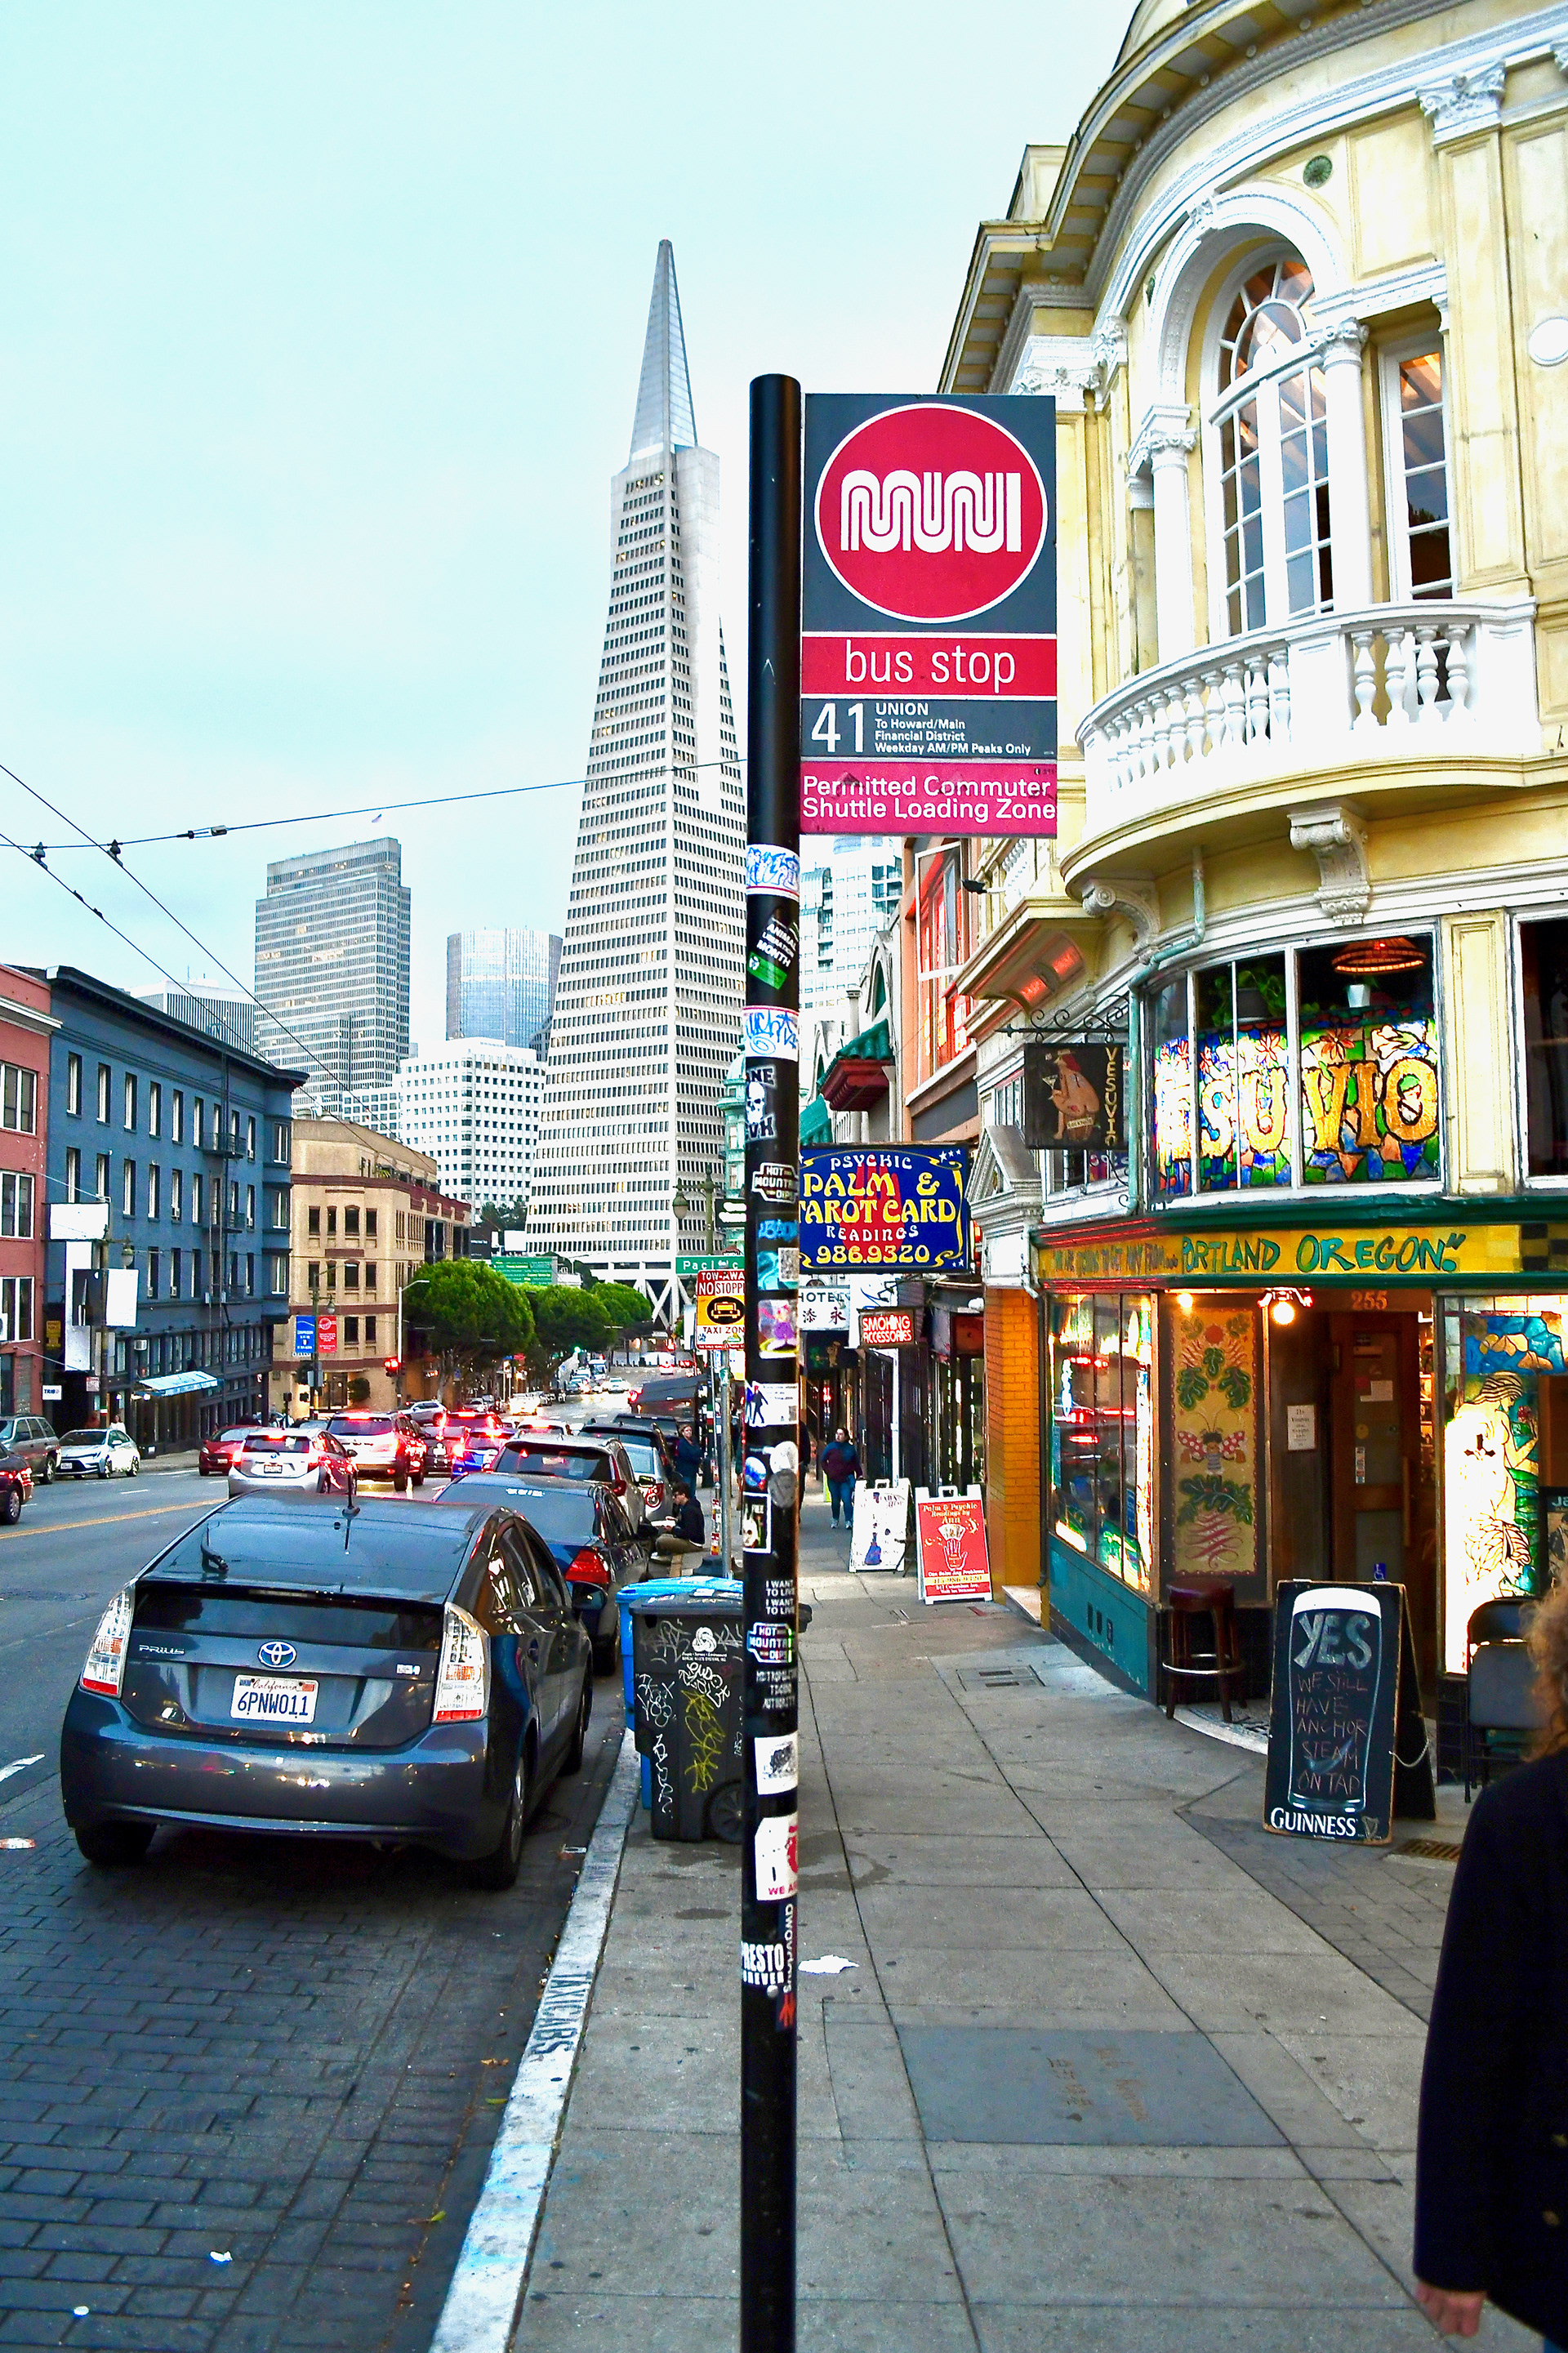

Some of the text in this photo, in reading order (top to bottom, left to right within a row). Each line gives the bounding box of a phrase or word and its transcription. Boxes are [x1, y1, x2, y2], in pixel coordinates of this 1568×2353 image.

[840, 470, 1022, 553] MUNI
[845, 639, 1015, 693] bus stop
[875, 702, 929, 715] UNION
[811, 702, 864, 752] 41
[875, 719, 965, 729] To Howard/Main
[875, 731, 965, 741] Financial District
[875, 742, 924, 755] Weekday
[927, 743, 969, 754] AM/PM
[972, 744, 1003, 754] Peaks
[1005, 744, 1031, 756] Only
[804, 776, 1050, 796] Permitted Commuter
[803, 797, 1056, 823] Shuttle Loading Zone
[756, 939, 791, 967] MONTH
[1104, 1046, 1118, 1147] VESUVIO
[830, 1153, 912, 1170] PSYCHIC
[803, 1171, 940, 1197] PALM &
[883, 1199, 956, 1223] CARD
[826, 1225, 919, 1241] READINGS
[816, 1245, 930, 1263] 986.9320
[1182, 1236, 1281, 1272] PORTLAND
[702, 1272, 745, 1281] TOW-AWA
[699, 1282, 715, 1295] NO
[1352, 1290, 1388, 1310] 255
[862, 1314, 911, 1331] SMOKING
[765, 1588, 778, 1597] TO
[765, 1607, 778, 1615] TO
[139, 1644, 185, 1655] PRIUS
[1294, 1611, 1372, 1669] YES
[252, 1679, 297, 1692] California
[1298, 1672, 1323, 1693] WE
[237, 1691, 309, 1716] 6PNW011
[1296, 1696, 1348, 1715] HAVE
[1302, 1740, 1359, 1771] STEAM
[1297, 1769, 1361, 1796] ON TAP
[1271, 1807, 1356, 1837] GUINNESS
[768, 1886, 786, 1896] WE
